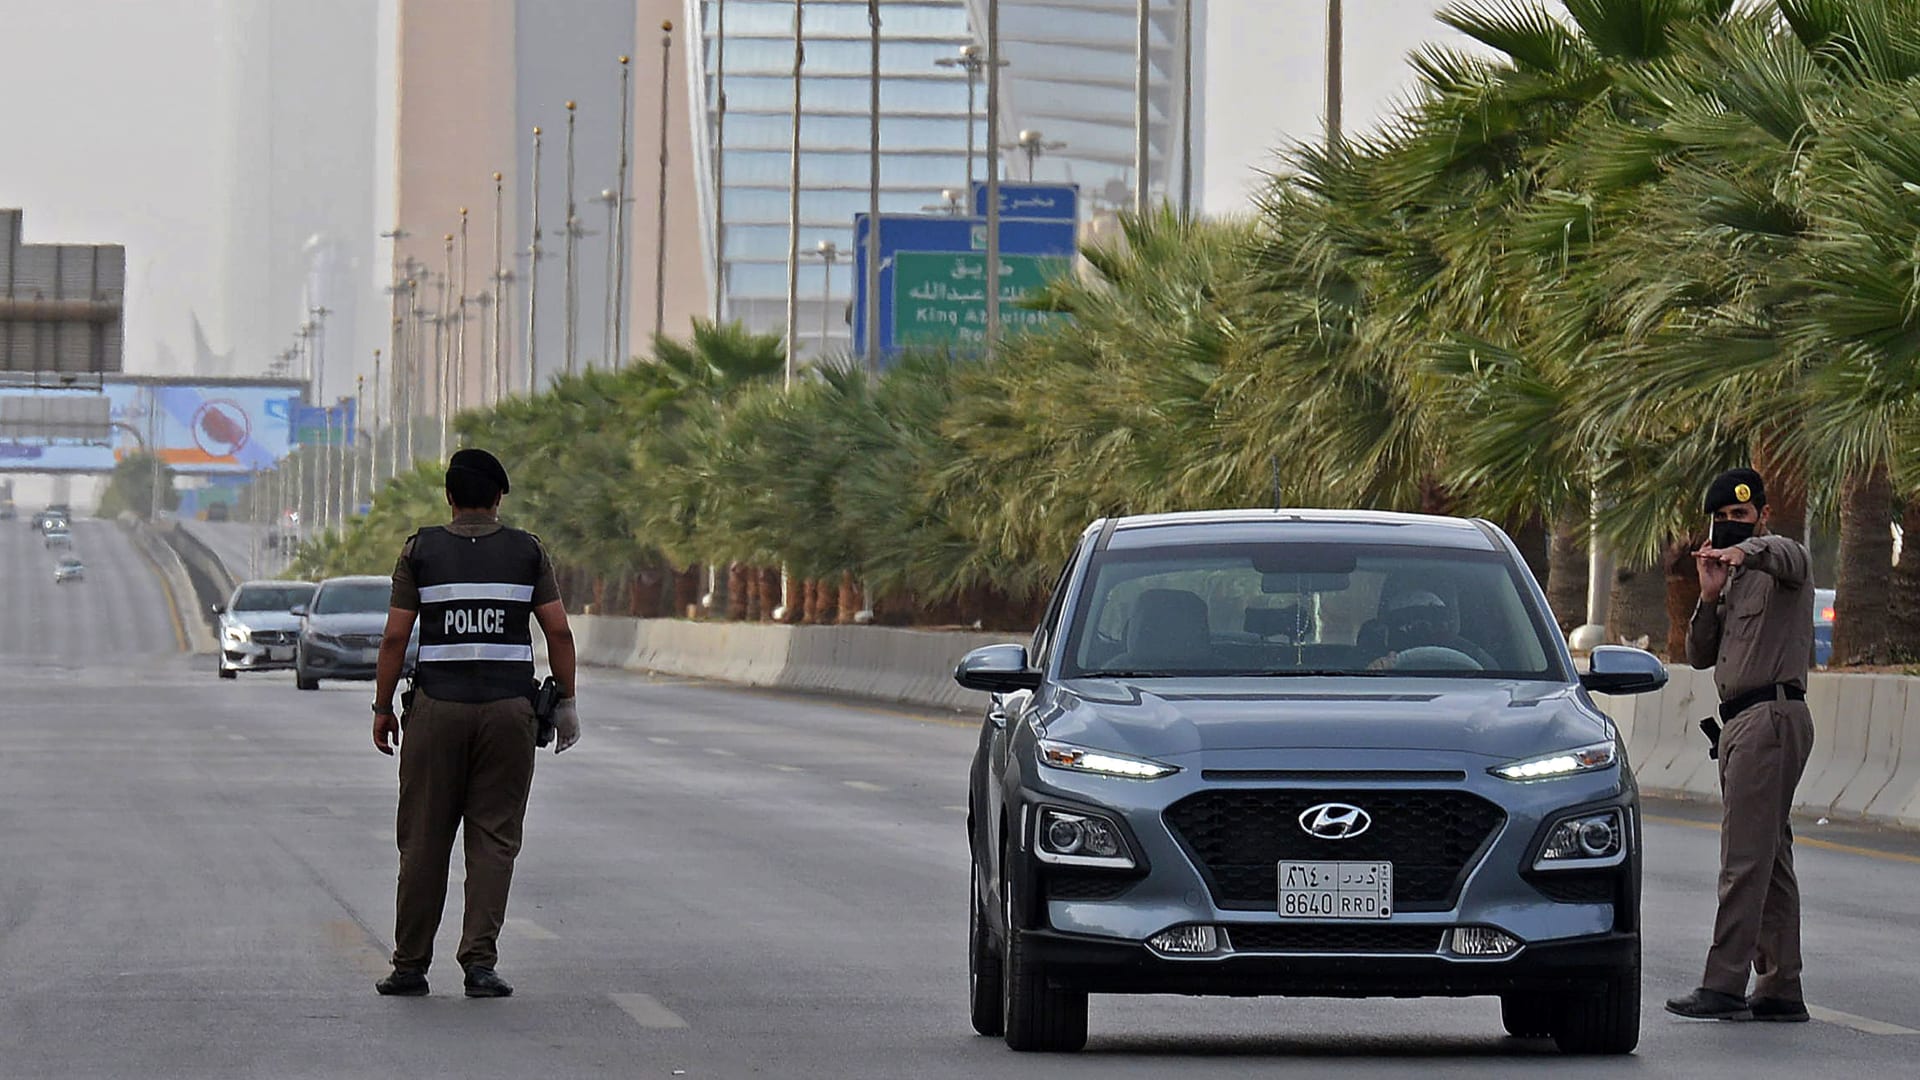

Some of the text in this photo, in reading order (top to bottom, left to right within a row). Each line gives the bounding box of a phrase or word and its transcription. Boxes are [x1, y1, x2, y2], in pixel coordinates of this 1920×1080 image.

[951, 258, 1014, 279] طيق
[916, 307, 1048, 325] King Abullah
[444, 608, 505, 634] POLICE
[1285, 893, 1375, 914] 8640 RRD
